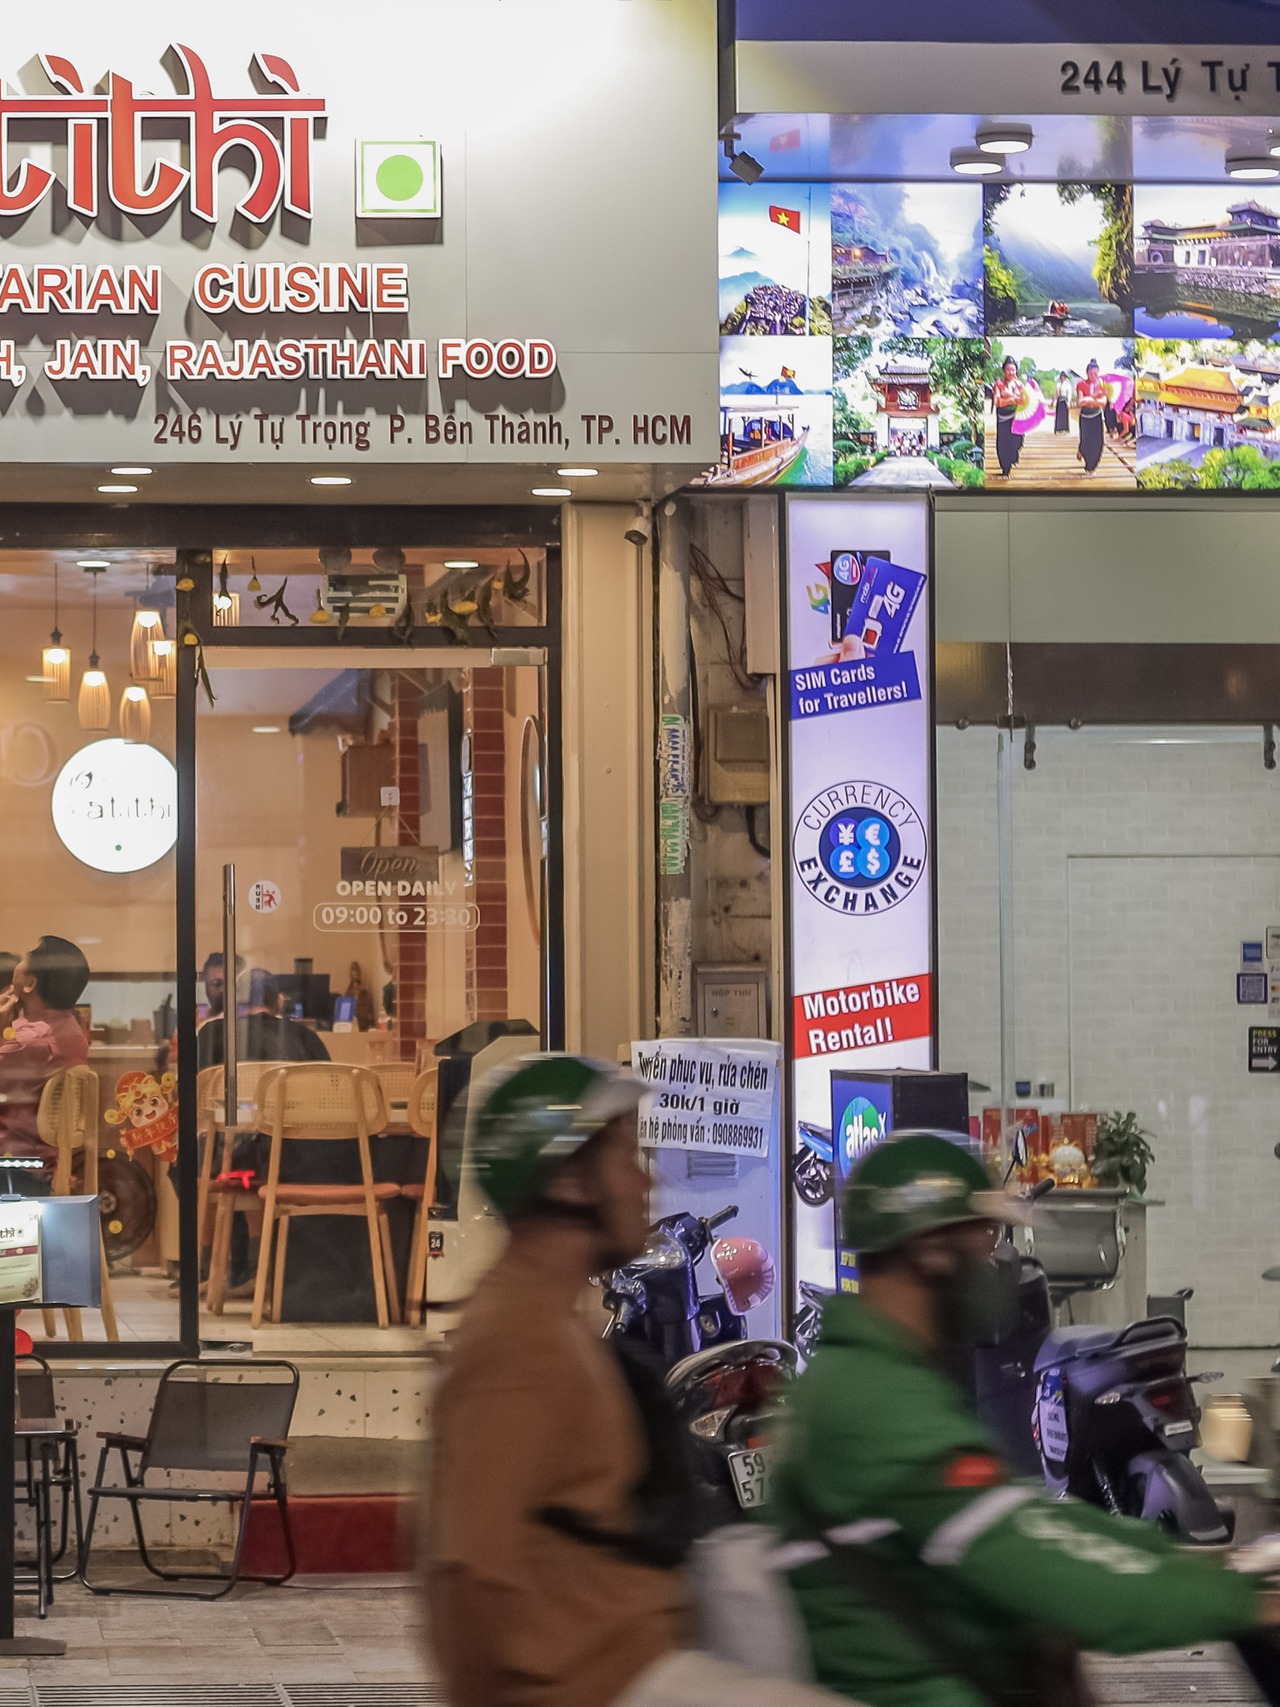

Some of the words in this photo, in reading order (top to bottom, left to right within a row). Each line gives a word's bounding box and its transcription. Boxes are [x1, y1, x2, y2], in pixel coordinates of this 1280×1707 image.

[1060, 60, 1127, 95] 244
[1141, 58, 1181, 102] Lý
[1201, 61, 1250, 101] Tự
[194, 263, 410, 314] CUISINE
[44, 339, 151, 387] JAIN,
[167, 339, 426, 380] RAJASTHANI
[438, 338, 557, 380] FOOD
[153, 413, 202, 445] 246
[215, 413, 243, 451] Lý
[254, 413, 285, 451] Tự
[296, 413, 371, 452] Trọng
[389, 414, 413, 445] P.
[484, 413, 570, 451] Thành,
[580, 414, 620, 445] TP.
[632, 414, 692, 445] HCM
[884, 581, 906, 618] 4G
[794, 669, 827, 691] SIM
[829, 663, 876, 686] Cards
[798, 697, 821, 714] for
[823, 680, 908, 710] Travellers!
[803, 784, 918, 831] CURRENCY
[360, 850, 419, 880] Open
[799, 855, 922, 912] EXCHANGE
[336, 880, 392, 896] OPEN
[397, 880, 457, 896] DAILY
[321, 906, 382, 925] 09:00
[387, 908, 408, 925] to
[802, 978, 921, 1022] Motorbike
[808, 1016, 894, 1055] Rental!
[1252, 1045, 1278, 1054] ENTRY
[669, 1053, 696, 1090] phục
[699, 1060, 715, 1092] vụ,
[739, 1060, 768, 1090] chén
[659, 1092, 705, 1112] 30k/1
[713, 1098, 740, 1116] giờ
[648, 1116, 659, 1145] hệ
[712, 1122, 764, 1150] 0908869931
